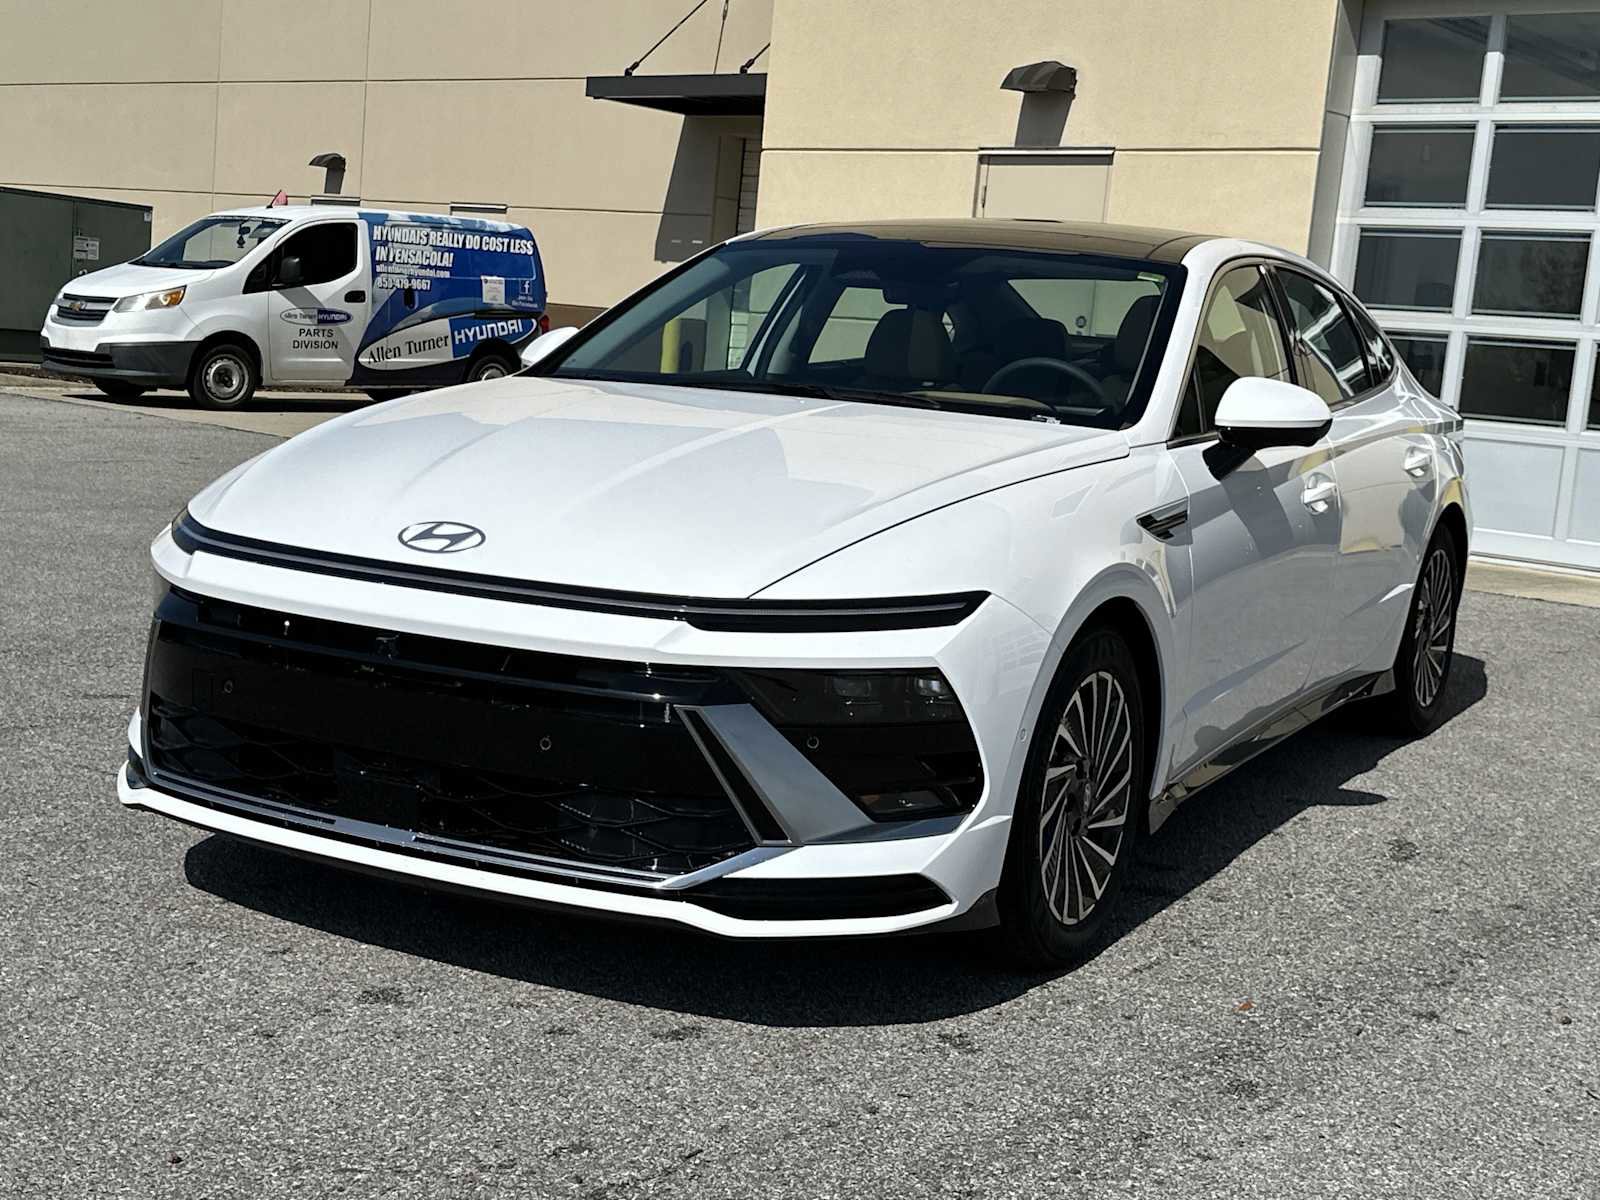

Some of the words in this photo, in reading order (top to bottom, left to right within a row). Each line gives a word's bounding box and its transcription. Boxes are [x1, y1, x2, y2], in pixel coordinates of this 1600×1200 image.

[373, 225, 428, 245] HYUNDAIS
[428, 232, 464, 249] REALLY
[465, 237, 480, 250] DO
[482, 238, 510, 253] COST
[510, 240, 534, 255] LESS
[375, 245, 388, 261] IN
[388, 247, 454, 267] PENSACOLA!
[299, 328, 334, 338] PARTS
[368, 343, 401, 364] Allen
[405, 335, 449, 355] Turner
[454, 319, 523, 344] HYUNDAI
[292, 339, 339, 350] DIVISION
